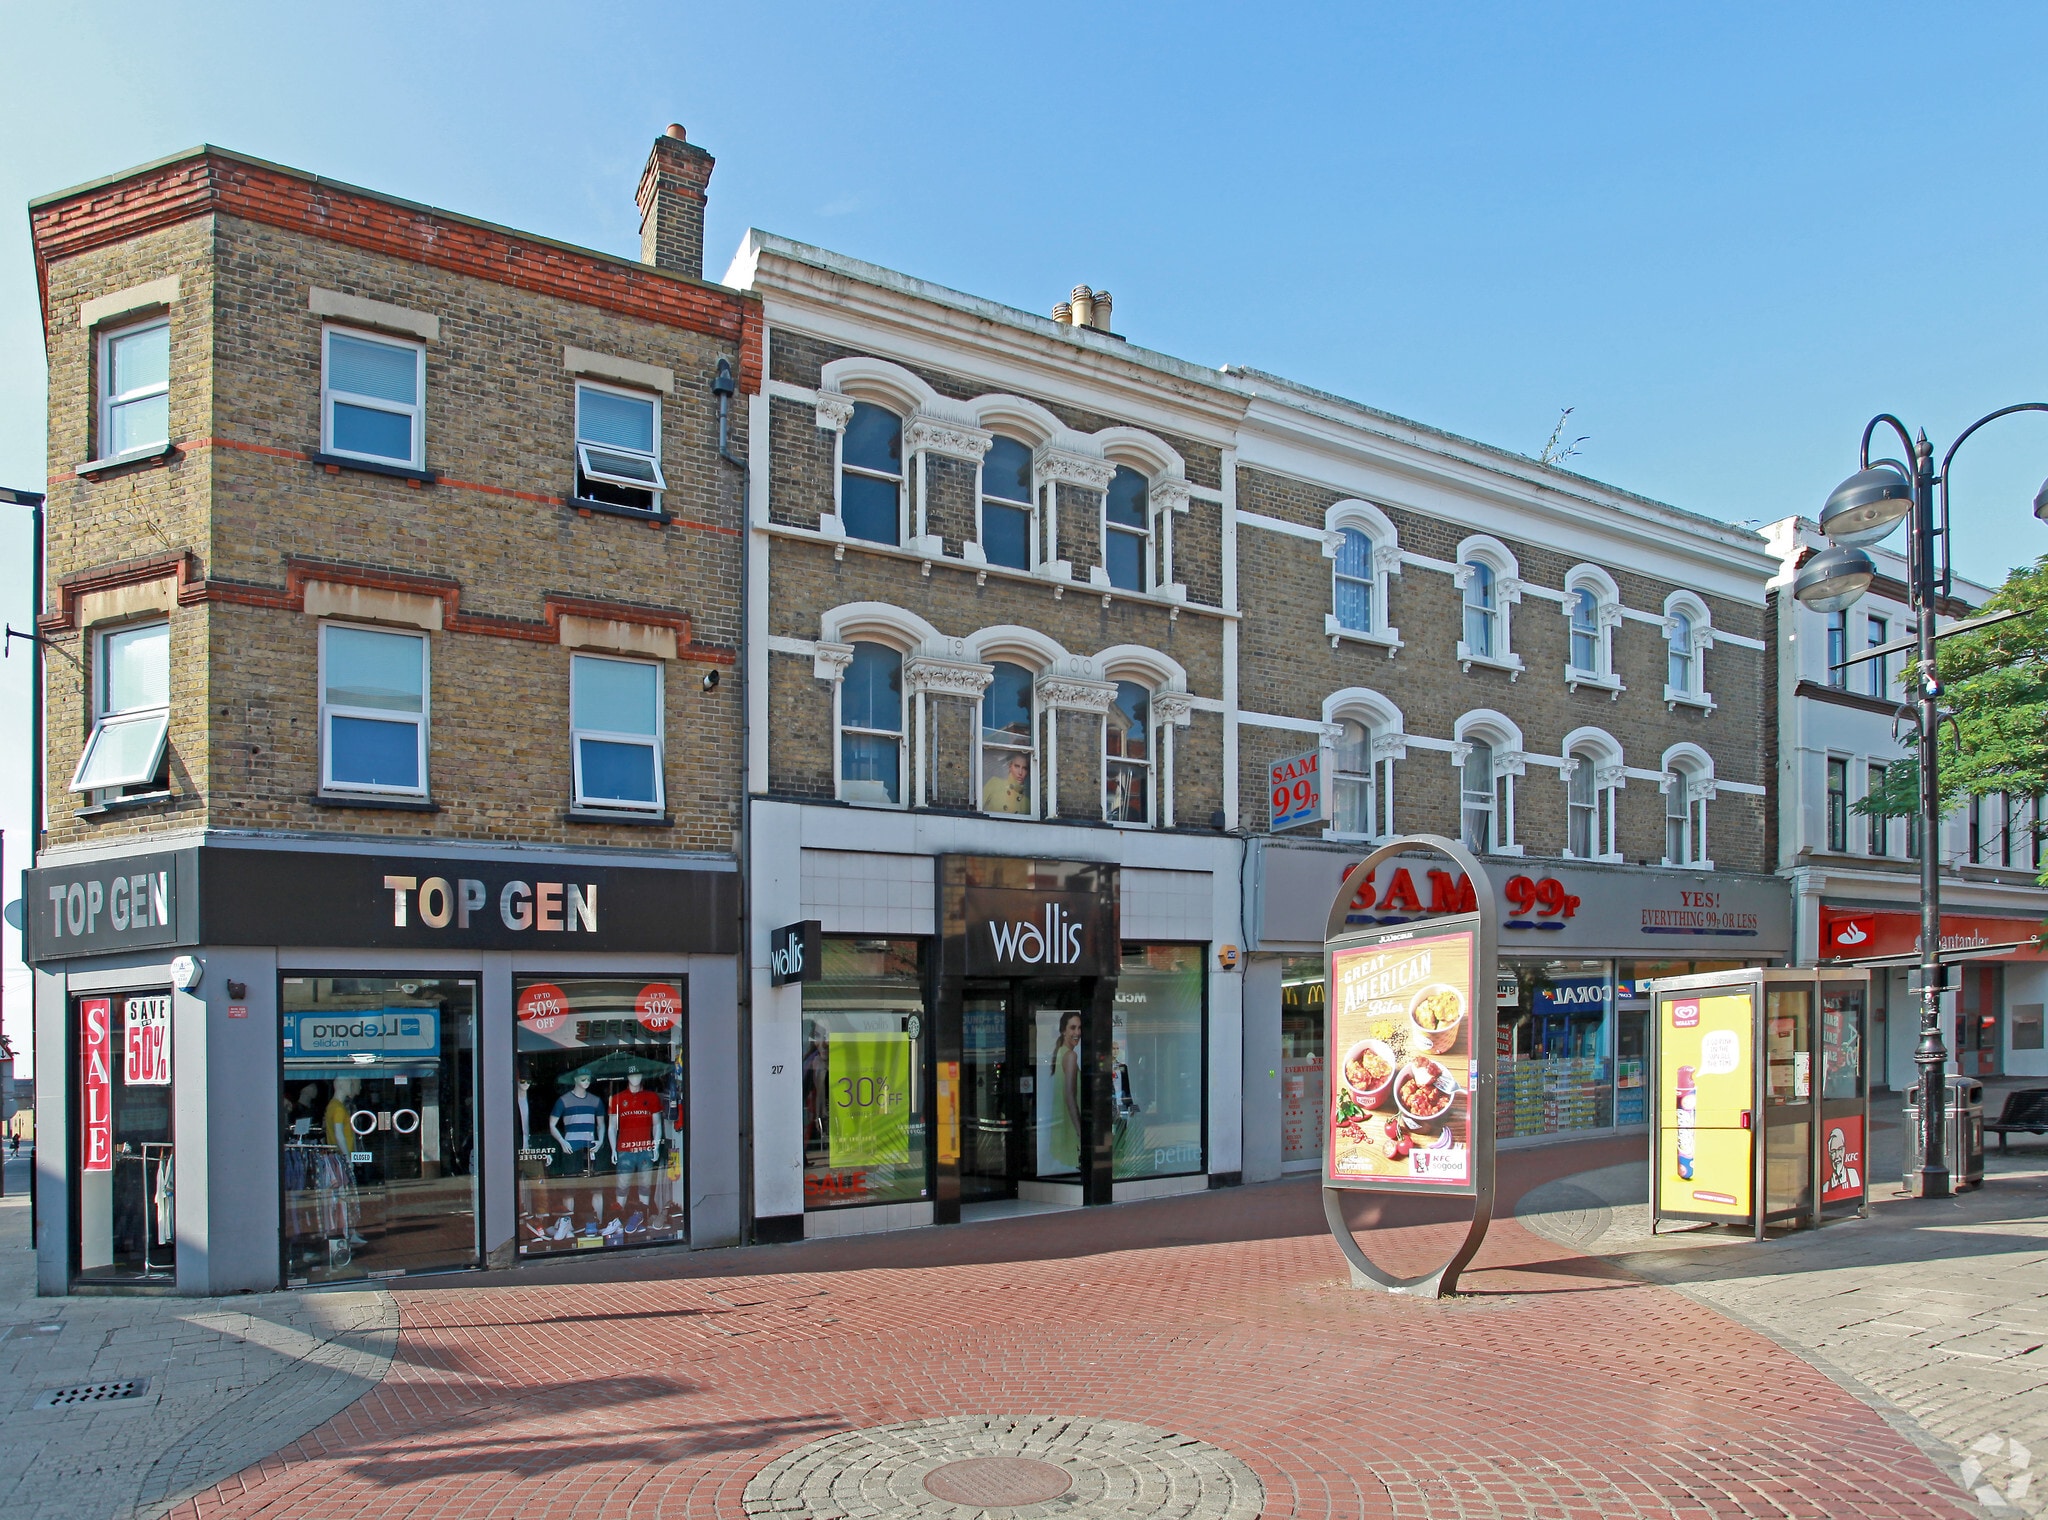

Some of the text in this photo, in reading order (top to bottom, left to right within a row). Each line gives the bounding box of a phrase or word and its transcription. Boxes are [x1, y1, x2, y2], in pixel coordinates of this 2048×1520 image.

[1272, 754, 1318, 785] SAM
[49, 871, 168, 937] TOP GEN
[384, 875, 597, 933] TOP GEN
[1680, 891, 1720, 908] YES!
[1642, 909, 1704, 927] EVERYTHING
[1722, 913, 1735, 928] OR
[1737, 913, 1758, 928] LESS
[989, 903, 1082, 963] wallis
[1938, 928, 1989, 949] antander
[772, 932, 803, 976] wallis
[1344, 954, 1386, 984] GREAT
[1344, 951, 1431, 1015] AMERICAN
[130, 1000, 165, 1020] SAVE
[527, 998, 560, 1020] 50%
[644, 998, 674, 1018] 50%
[536, 1017, 555, 1030] OFF
[651, 1016, 669, 1028] OFF
[129, 1026, 166, 1080] 50%
[771, 1065, 784, 1075] 217
[86, 1008, 108, 1162] SALE
[876, 1093, 903, 1107] OFF
[353, 1153, 370, 1161] CLOSED
[1154, 1144, 1203, 1170] petite
[1845, 1152, 1858, 1162] KFC
[804, 1171, 867, 1196] SALE
